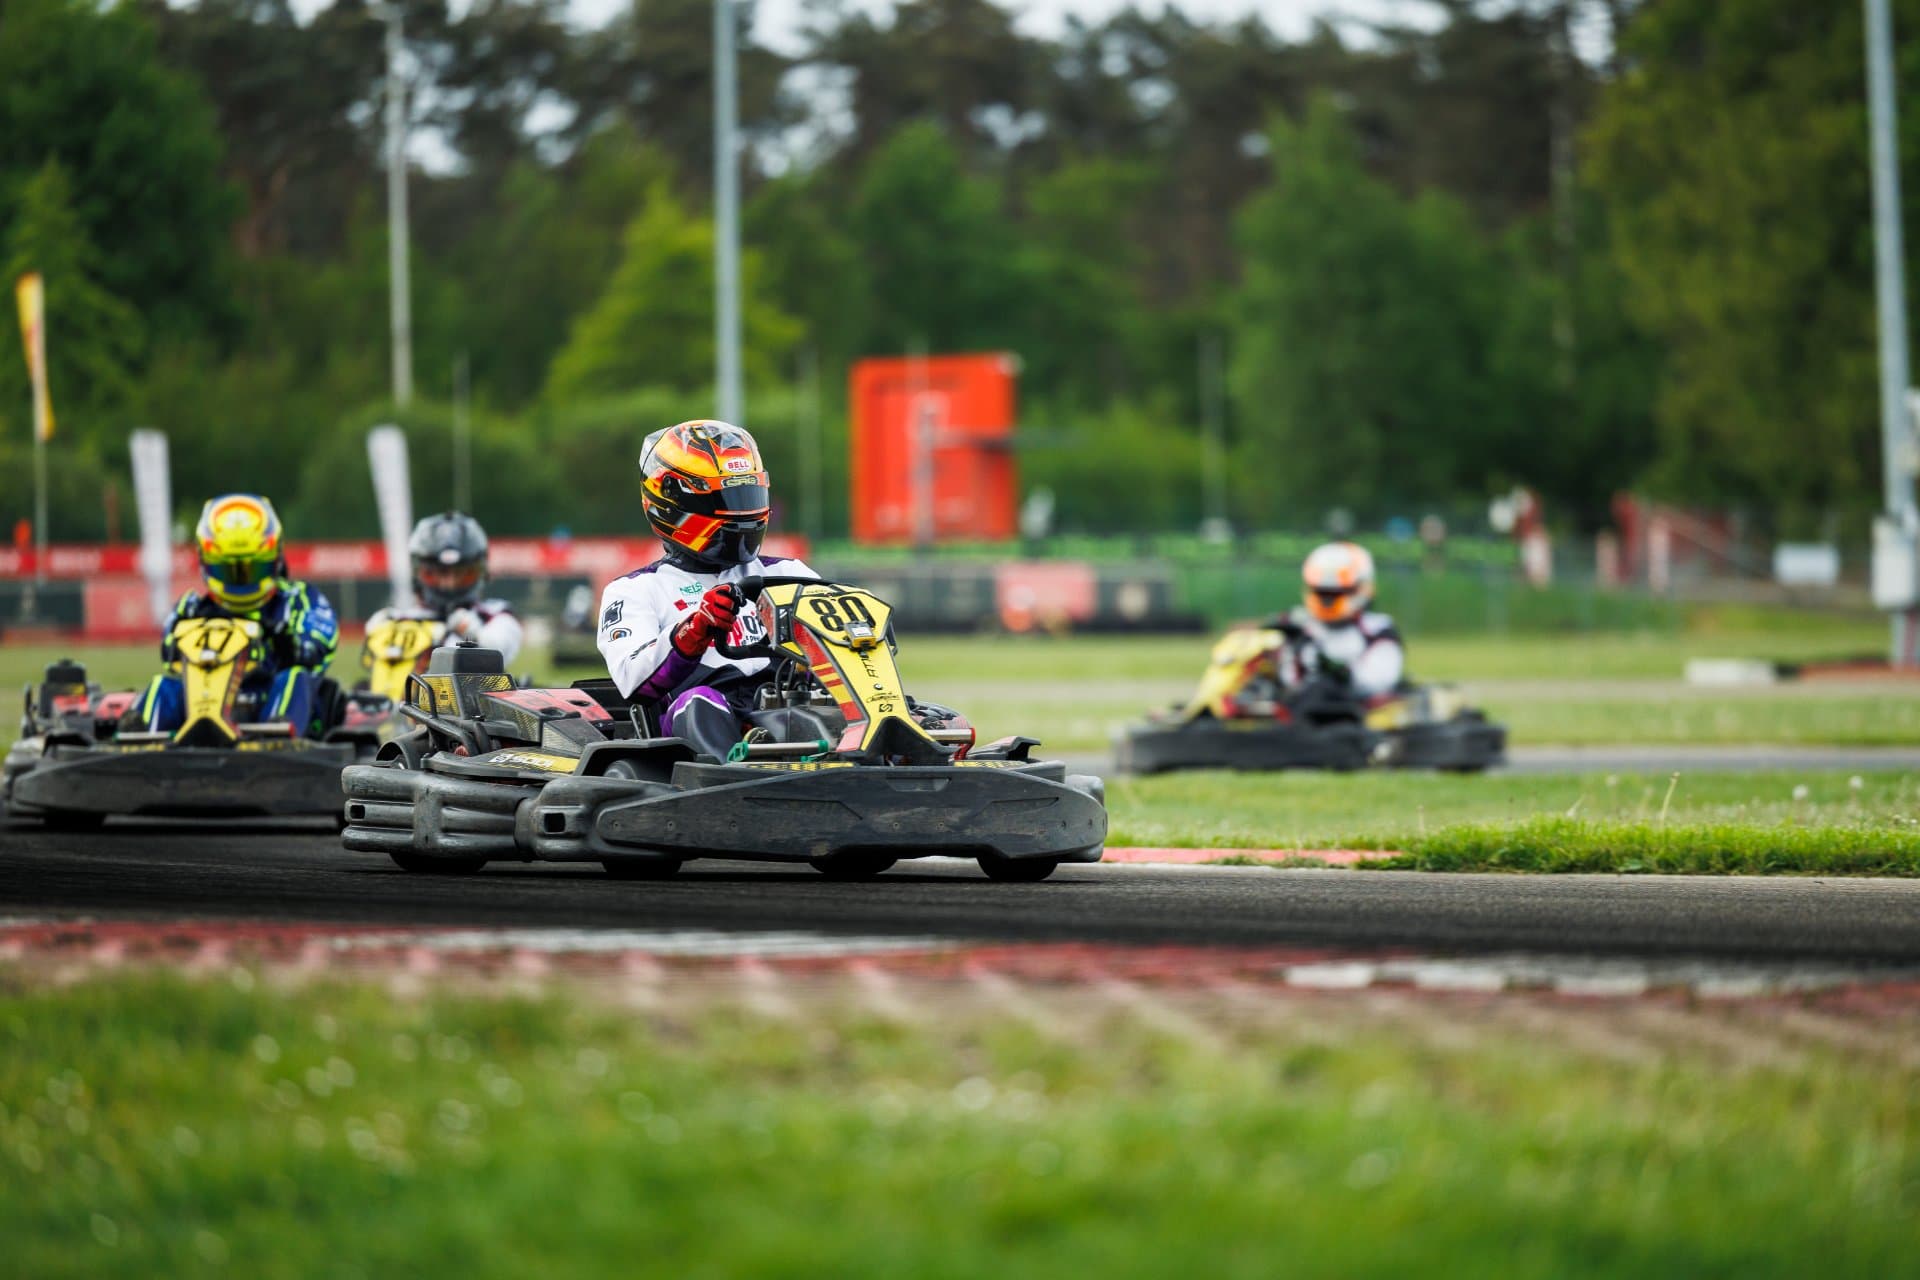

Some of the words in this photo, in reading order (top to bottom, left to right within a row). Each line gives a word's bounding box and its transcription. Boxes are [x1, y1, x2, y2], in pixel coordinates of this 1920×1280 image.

[727, 460, 749, 469] BELL
[809, 596, 876, 632] 80
[195, 628, 234, 654] 47
